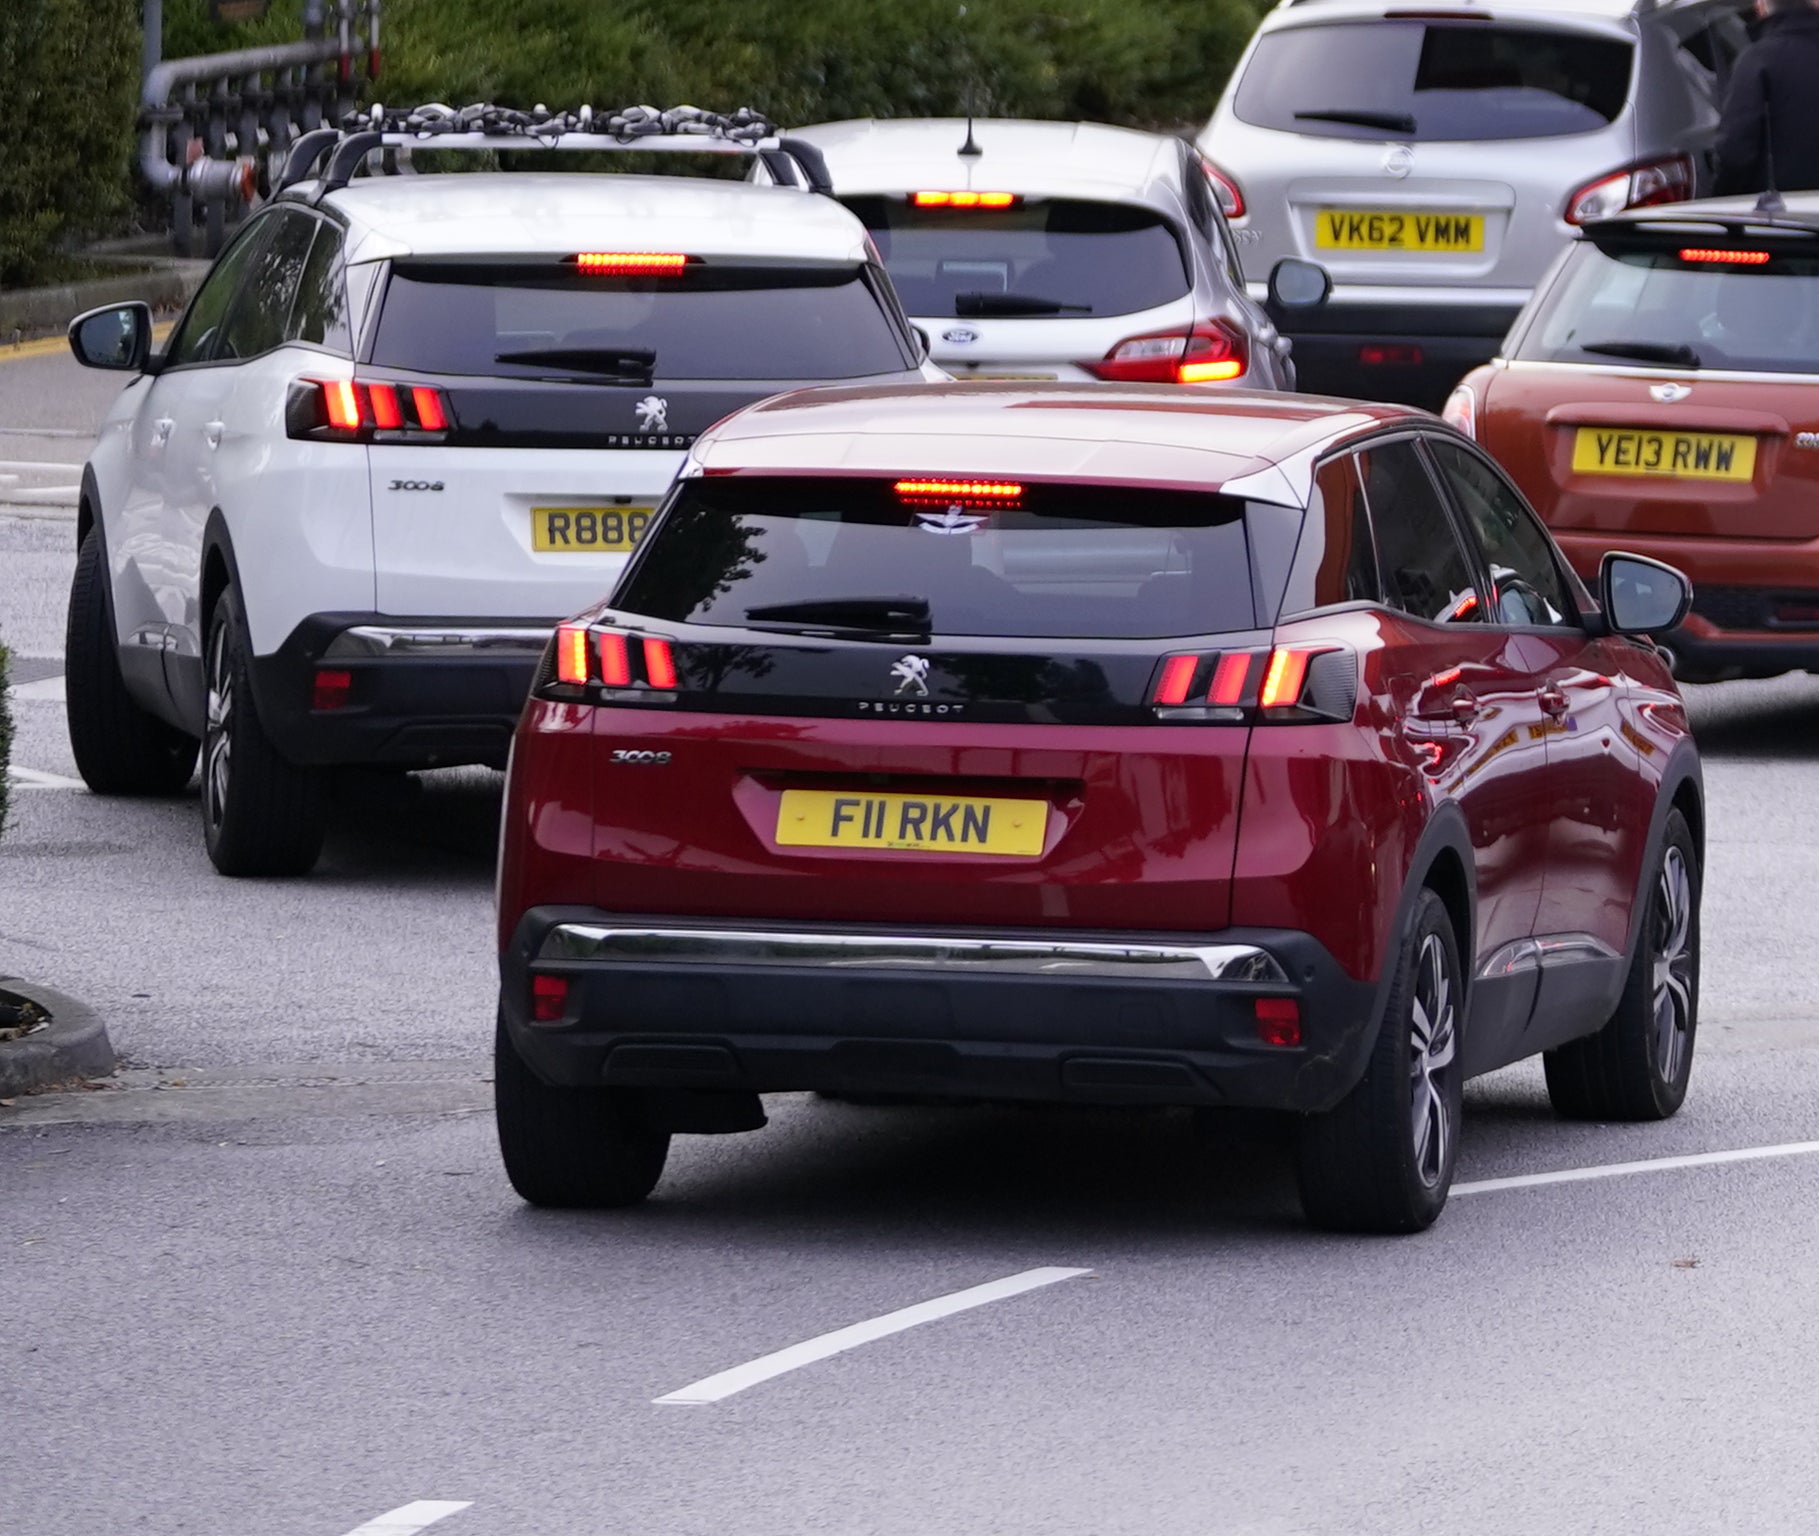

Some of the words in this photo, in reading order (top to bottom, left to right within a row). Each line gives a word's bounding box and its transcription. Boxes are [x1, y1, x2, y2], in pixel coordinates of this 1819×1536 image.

[1328, 214, 1405, 243] VK62
[1415, 215, 1471, 245] VMM
[1596, 433, 1664, 468] YE13
[1673, 436, 1736, 472] RWW
[858, 701, 964, 714] PEUGEOT
[608, 748, 673, 765] 3008
[897, 801, 992, 844] RKN
